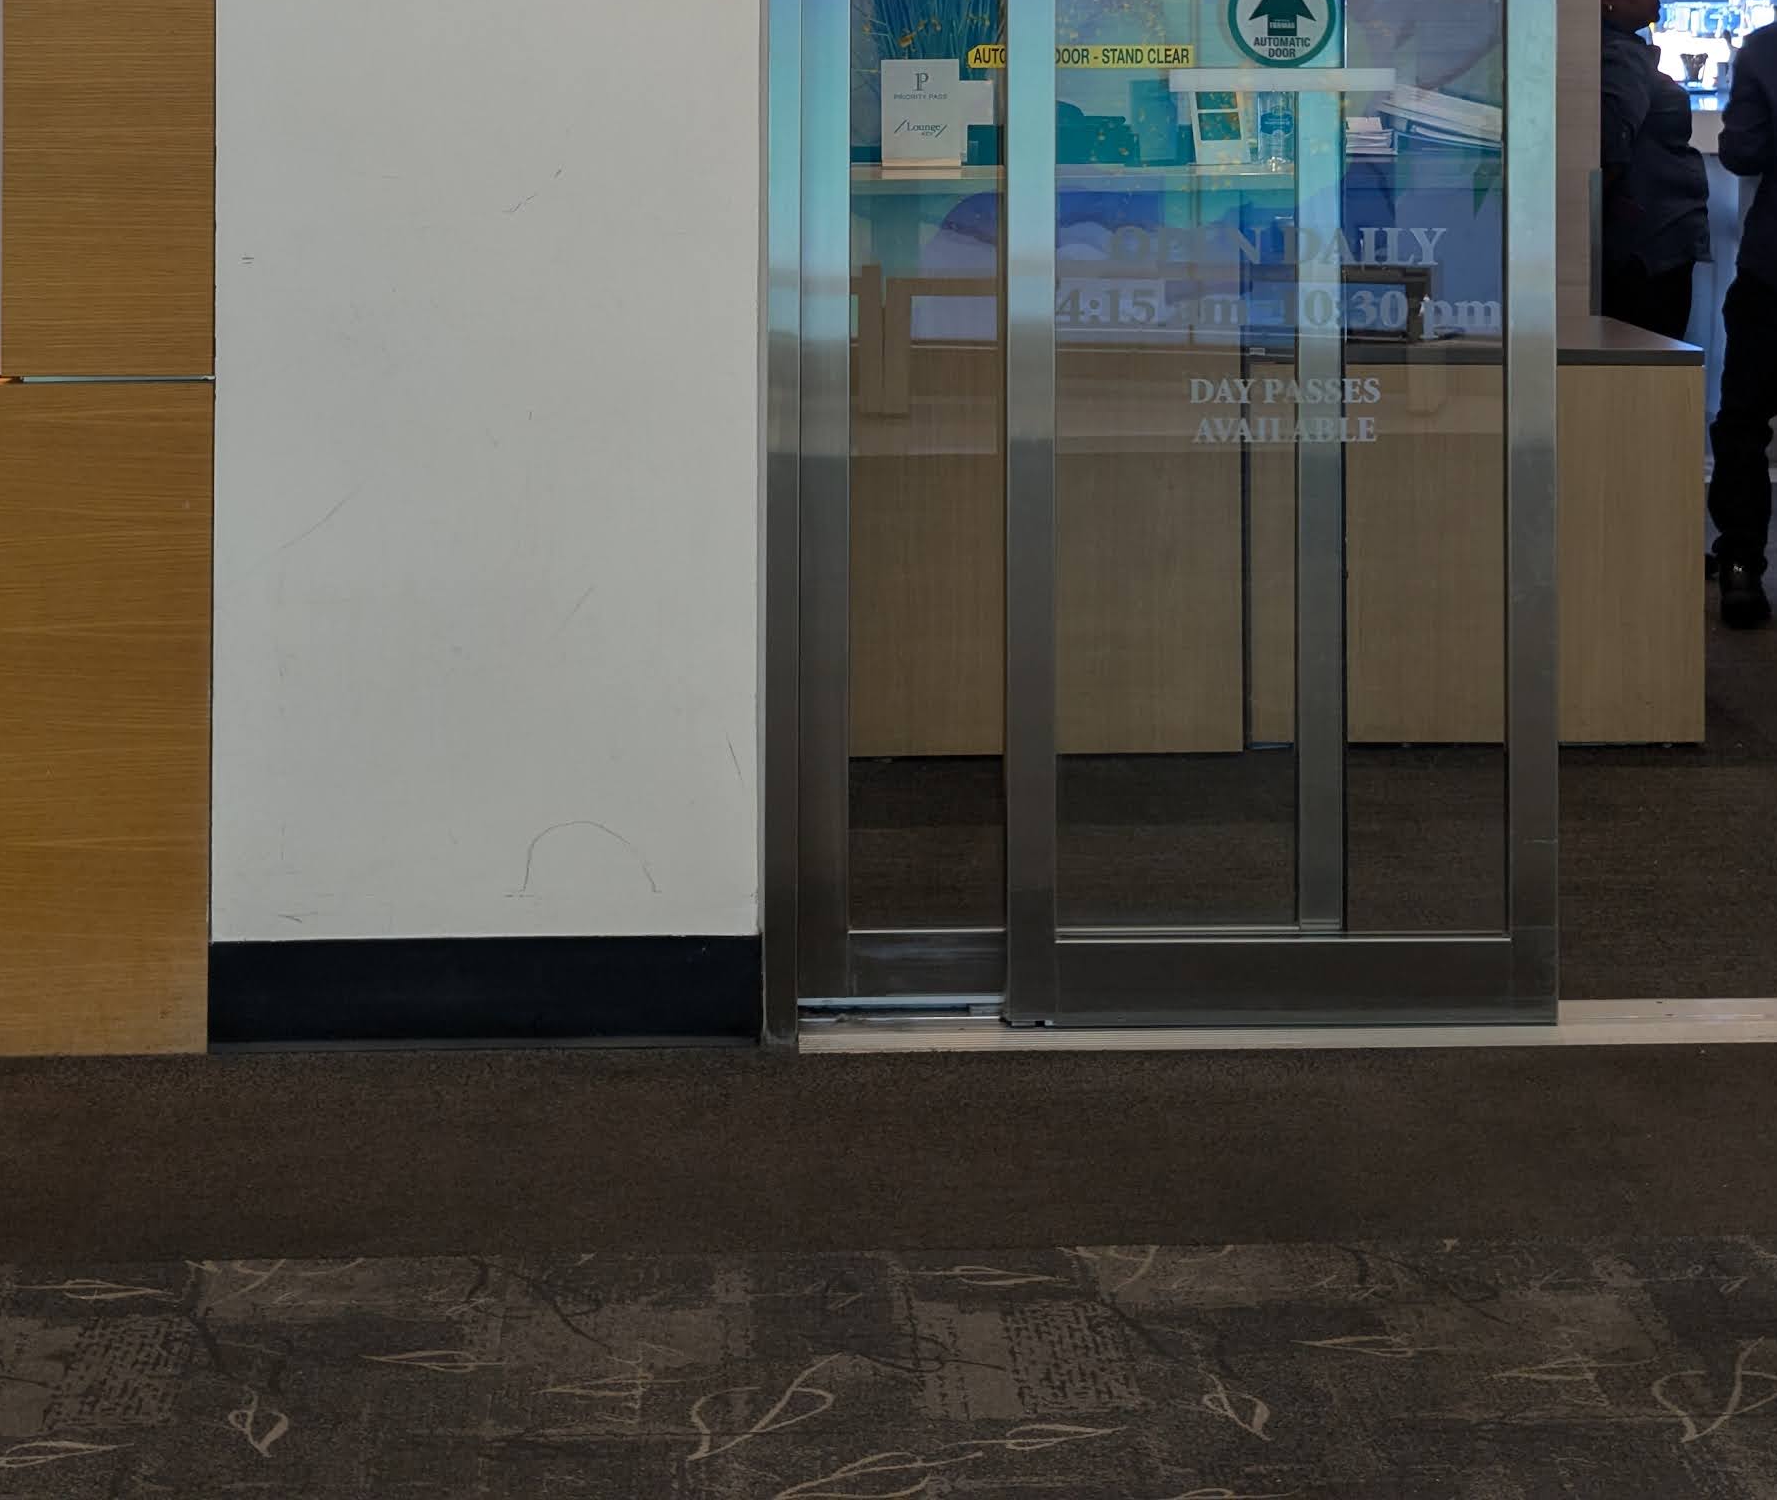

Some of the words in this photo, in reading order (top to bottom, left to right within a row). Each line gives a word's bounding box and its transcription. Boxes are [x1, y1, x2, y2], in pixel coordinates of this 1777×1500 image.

[1101, 48, 1144, 64] STAND
[1147, 48, 1189, 64] CLEAR
[1254, 37, 1311, 48] AUTOMATIC
[1268, 48, 1297, 58] DOOR
[1283, 226, 1448, 266] DAILY
[1419, 297, 1503, 340] pm
[1189, 378, 1257, 405] DAY
[1262, 377, 1381, 405] PASSES
[1192, 416, 1377, 443] AVAILABLE
